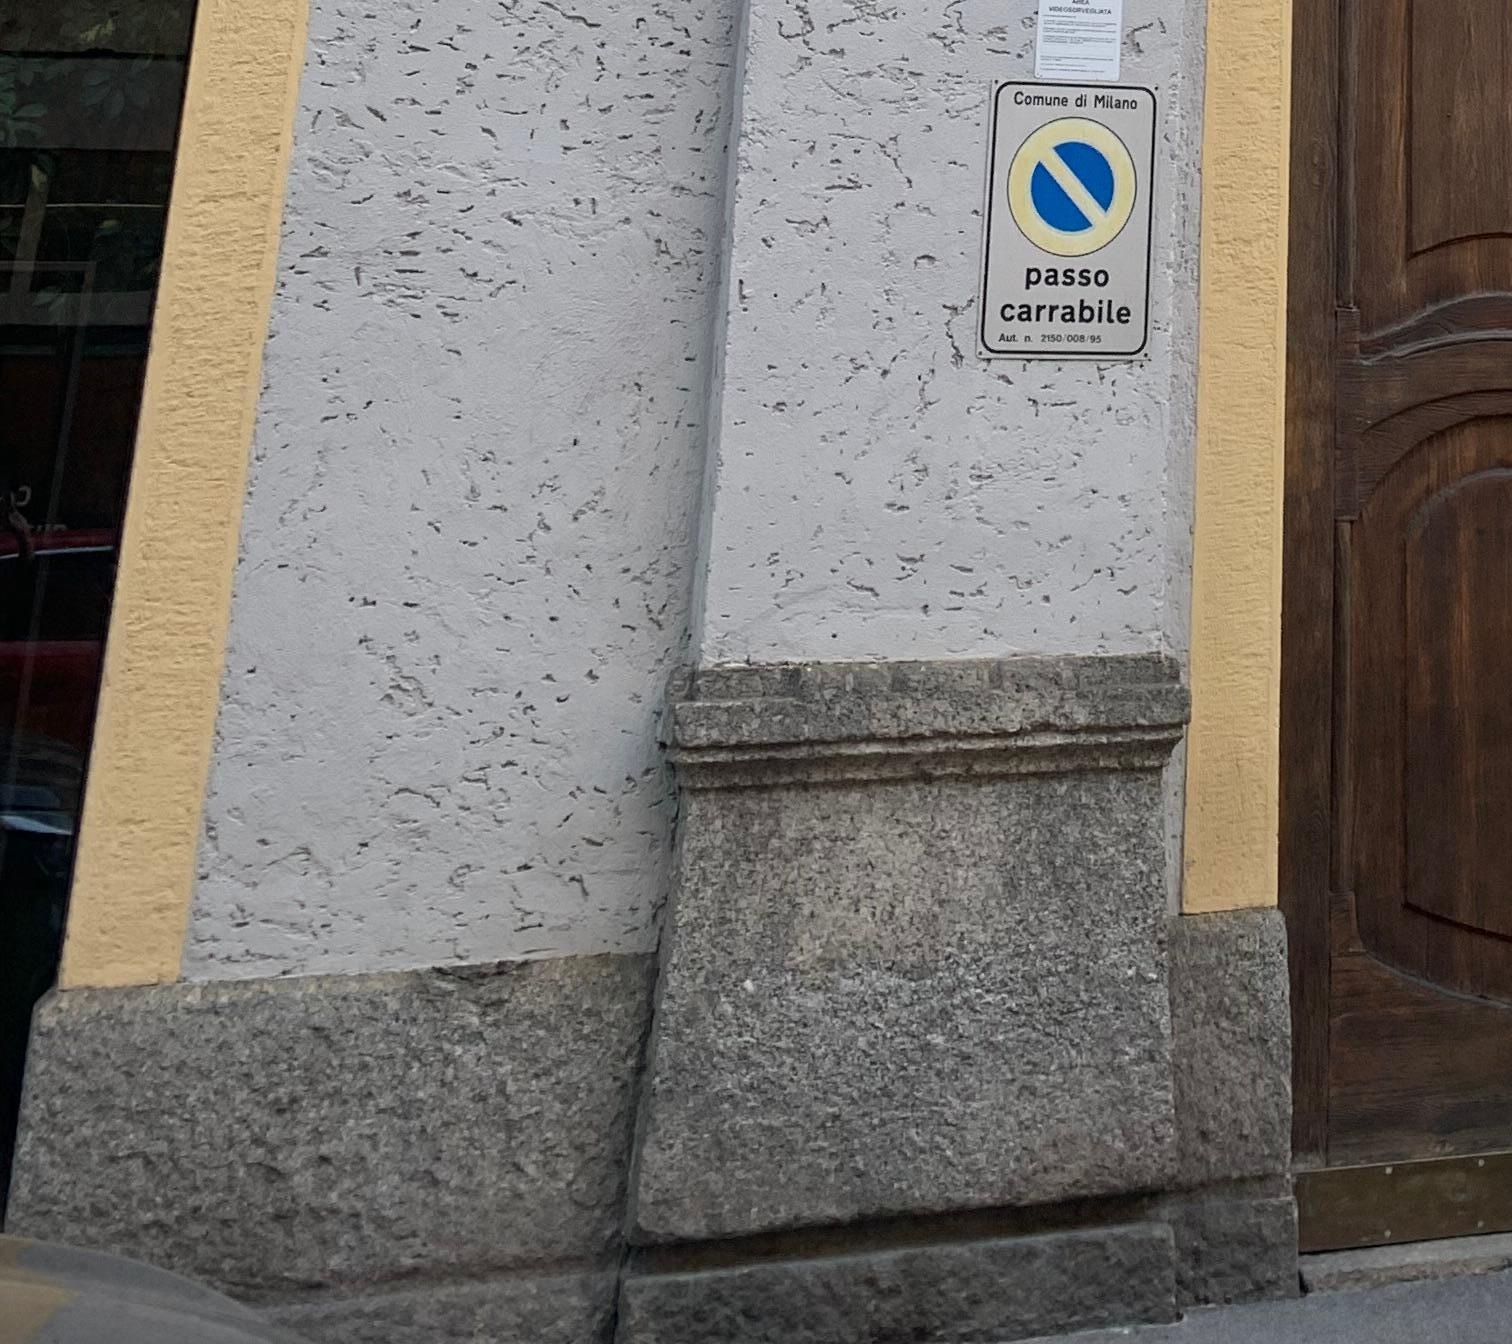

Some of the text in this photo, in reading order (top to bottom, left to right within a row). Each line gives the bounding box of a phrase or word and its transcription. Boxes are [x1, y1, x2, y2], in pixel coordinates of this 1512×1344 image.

[1014, 91, 1138, 110] Comune di Milano
[1025, 267, 1109, 290] passo
[1000, 299, 1131, 324] carrabile
[999, 333, 1018, 343] Aut.
[1024, 335, 1033, 343] n.
